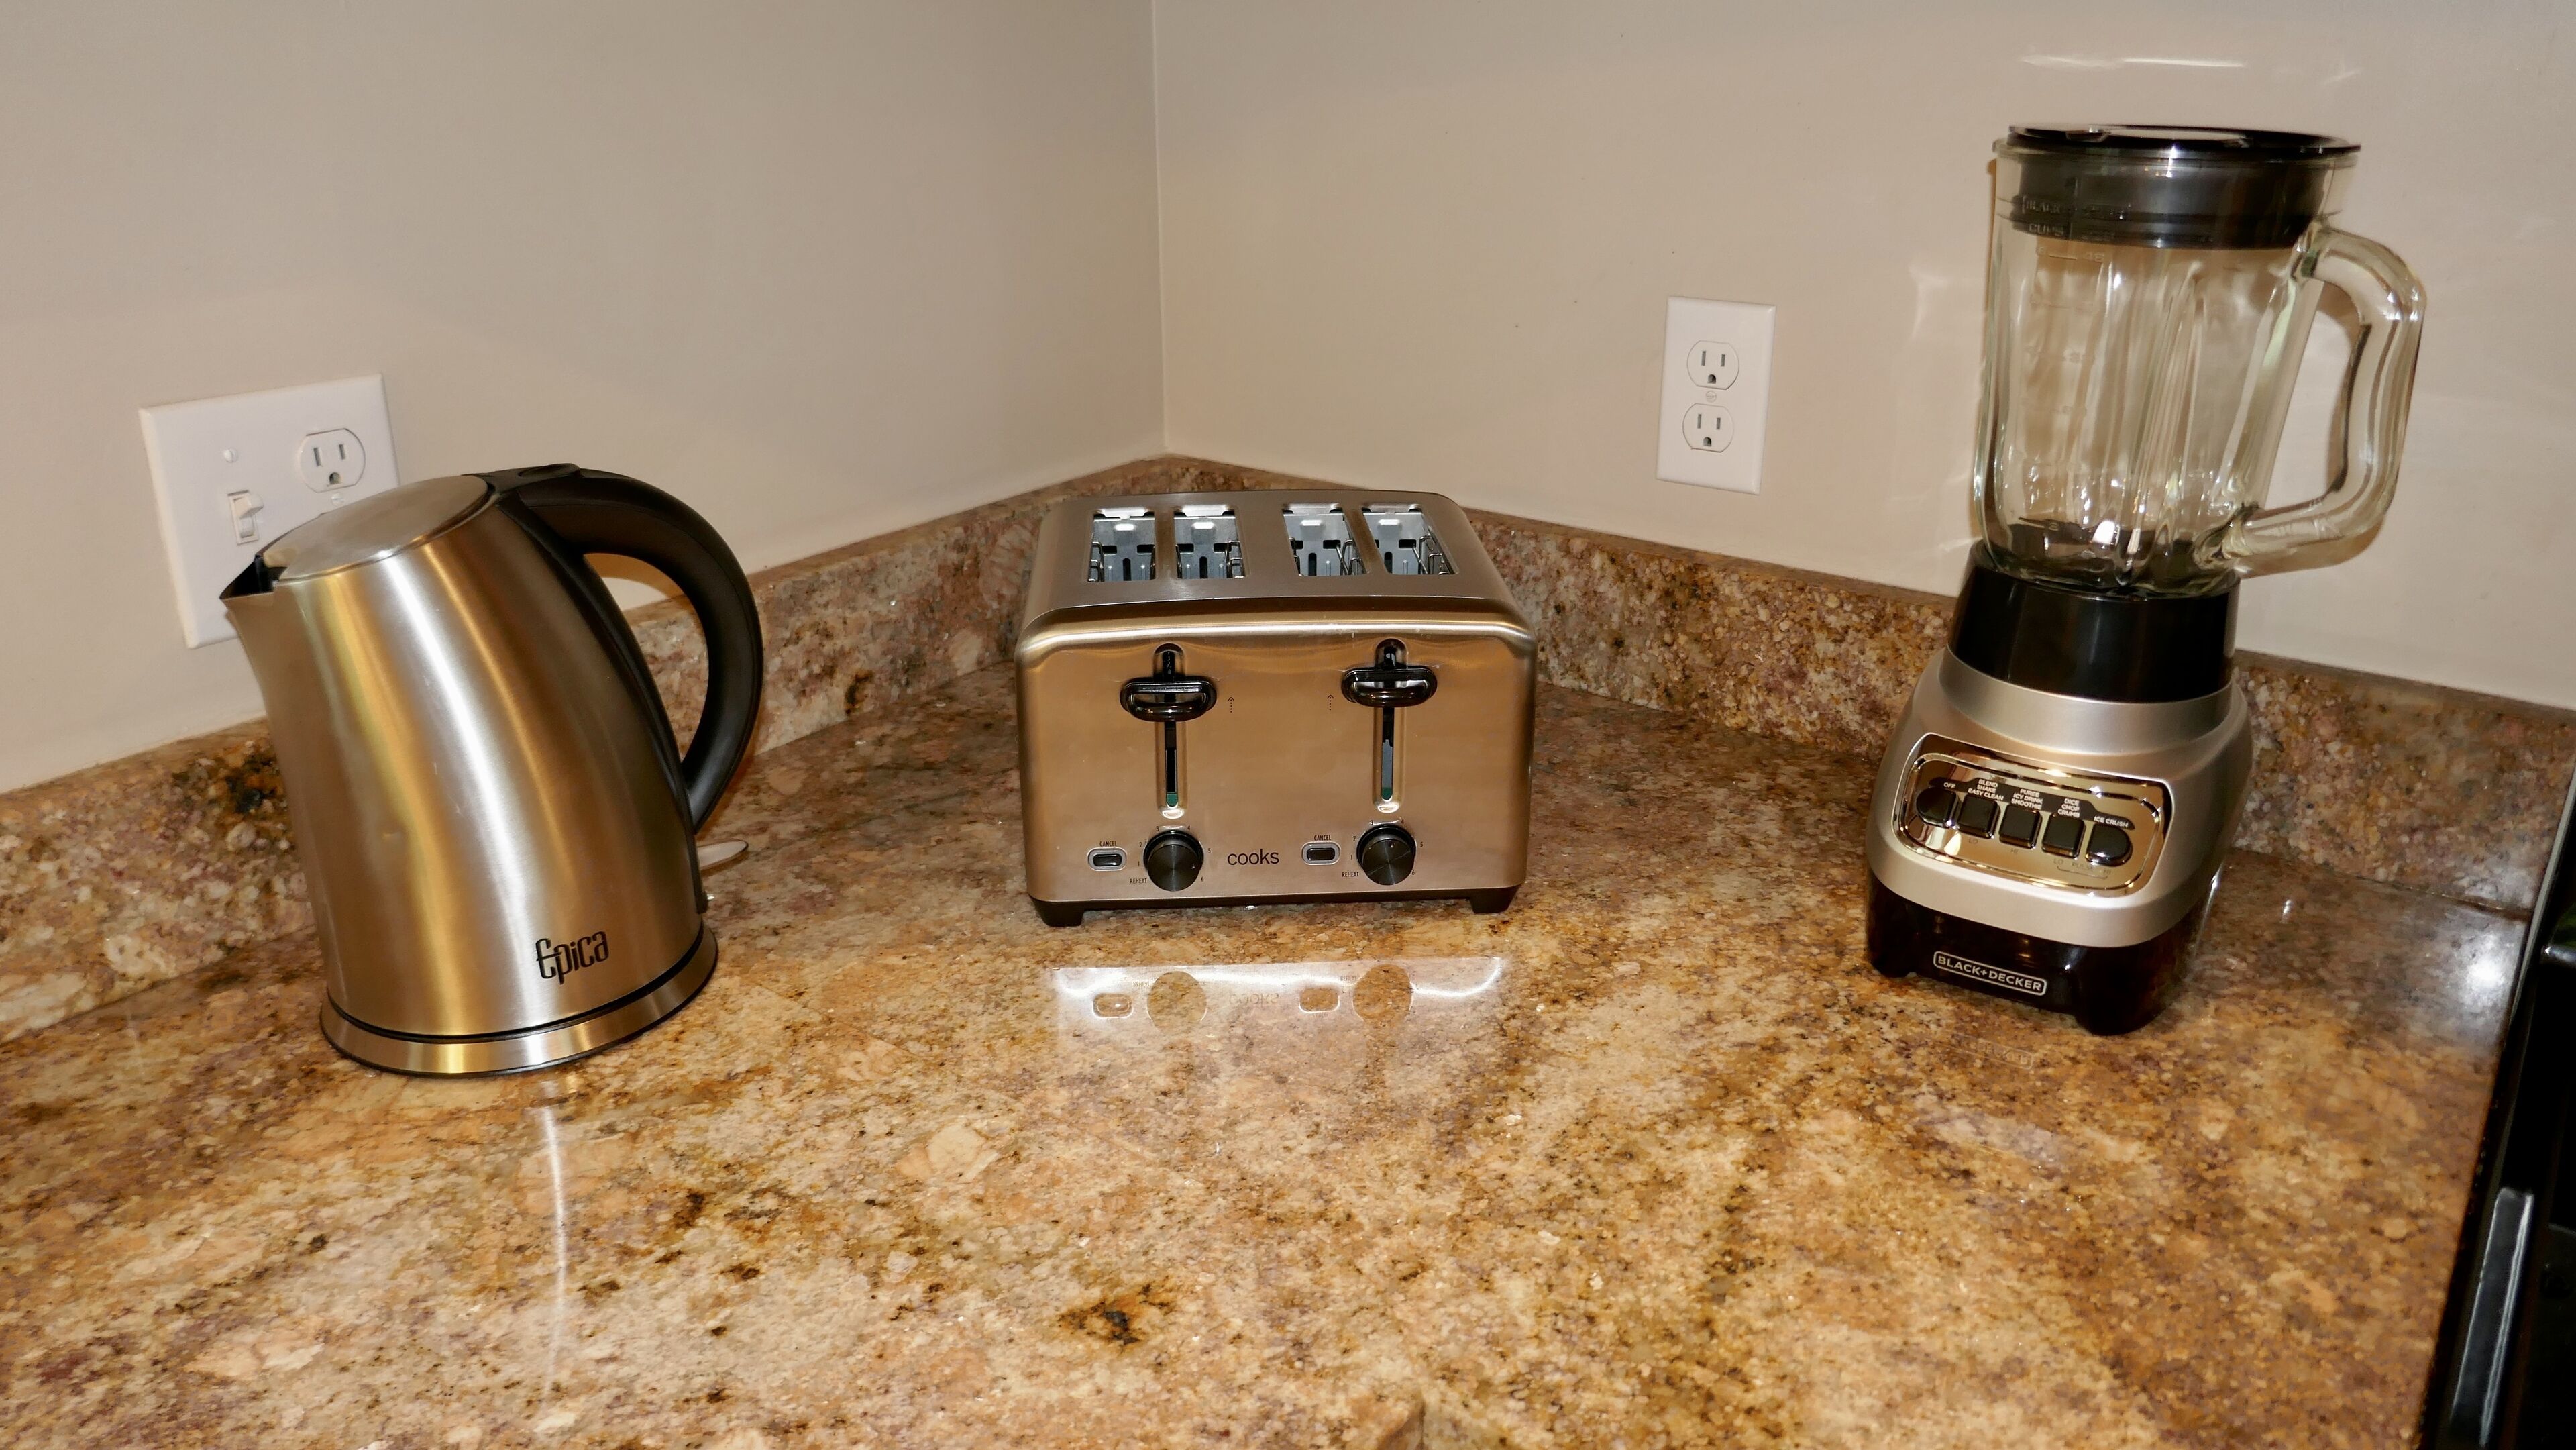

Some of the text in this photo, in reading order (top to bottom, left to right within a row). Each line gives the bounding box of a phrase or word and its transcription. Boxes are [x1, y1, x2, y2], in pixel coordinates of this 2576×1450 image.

[1976, 784, 1996, 794] SHAKE
[1978, 779, 1998, 788] BLEND
[1968, 788, 2004, 801] EASY CLEAN
[2020, 788, 2040, 798] PUREE
[2011, 798, 2043, 810] SMOOTHIE
[2024, 796, 2043, 805] DRINK
[2064, 798, 2080, 806] DICE
[2061, 803, 2080, 811] CHOP
[2094, 815, 2129, 828] ICE CRUSH
[1227, 848, 1280, 866] cooks
[535, 931, 610, 985] Epica
[1937, 955, 2042, 992] BLACK+DECKER
